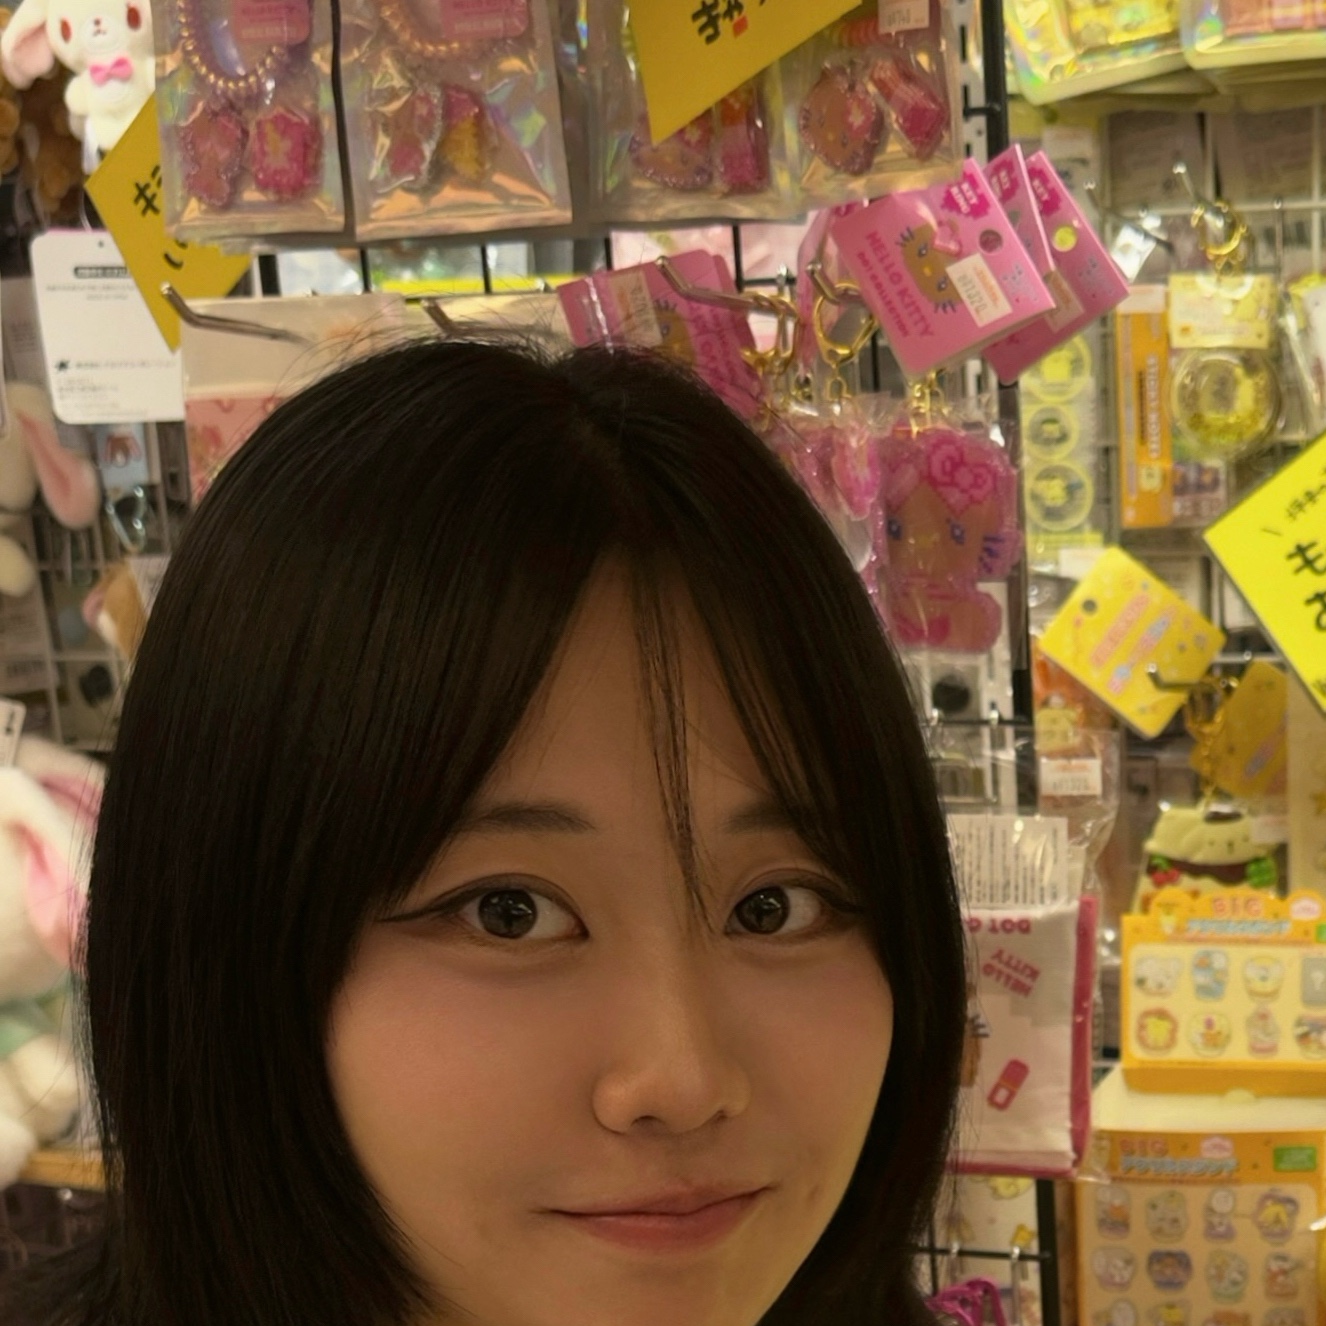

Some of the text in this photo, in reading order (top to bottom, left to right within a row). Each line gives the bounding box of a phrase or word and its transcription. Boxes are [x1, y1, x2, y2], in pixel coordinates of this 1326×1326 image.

[865, 230, 935, 339] HELLO KITTY
[1211, 898, 1264, 917] BIG
[987, 917, 1032, 935] DOT
